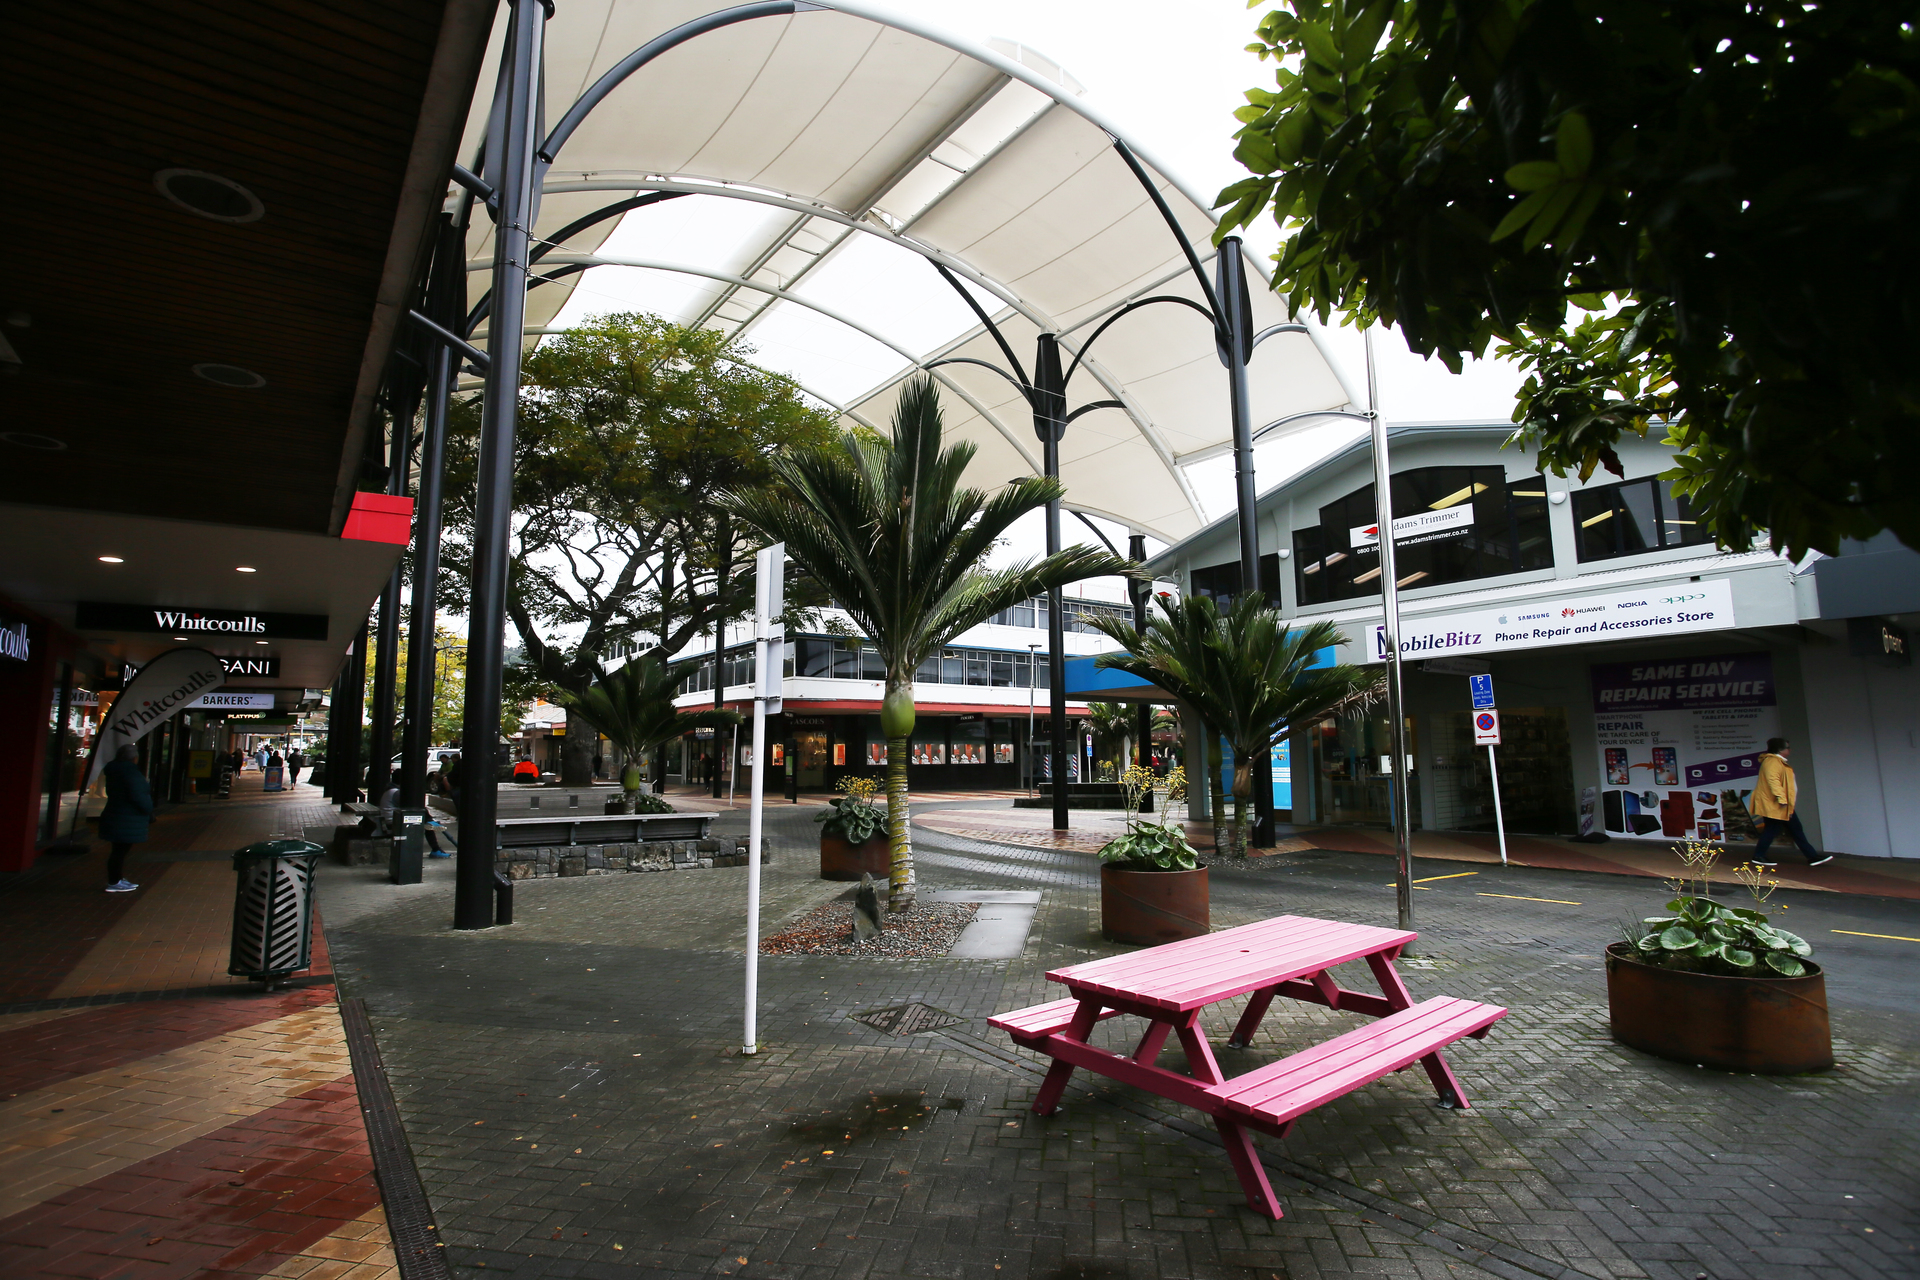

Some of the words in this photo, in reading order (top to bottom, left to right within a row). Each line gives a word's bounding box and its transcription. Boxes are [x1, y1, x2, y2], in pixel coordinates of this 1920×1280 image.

[1393, 520, 1418, 531] dams
[1419, 511, 1460, 526] Trimmer
[1396, 529, 1469, 547] www.adamstrimmer.co.nz
[1356, 547, 1370, 555] 0800
[1576, 605, 1606, 615] HUAWEI
[1617, 600, 1648, 609] NOKIA
[154, 611, 266, 633] Whitcoulls
[1517, 613, 1550, 622] SAMSUNG
[1495, 632, 1529, 643] Phone
[1532, 626, 1571, 639] Repair
[1574, 623, 1597, 634] and
[1599, 617, 1673, 632] Accessories
[1676, 611, 1715, 624] Store
[0, 622, 31, 662] coulls
[219, 658, 270, 675] GANI
[1631, 664, 1687, 682] SAME
[1690, 661, 1735, 678] DAY
[1477, 676, 1484, 684] P
[1599, 685, 1672, 703] REPAIR
[1675, 680, 1767, 699] SERVICE
[110, 671, 217, 737] Whitcoulls
[203, 696, 250, 706] BARKERS
[1597, 721, 1644, 731] REPAIR
